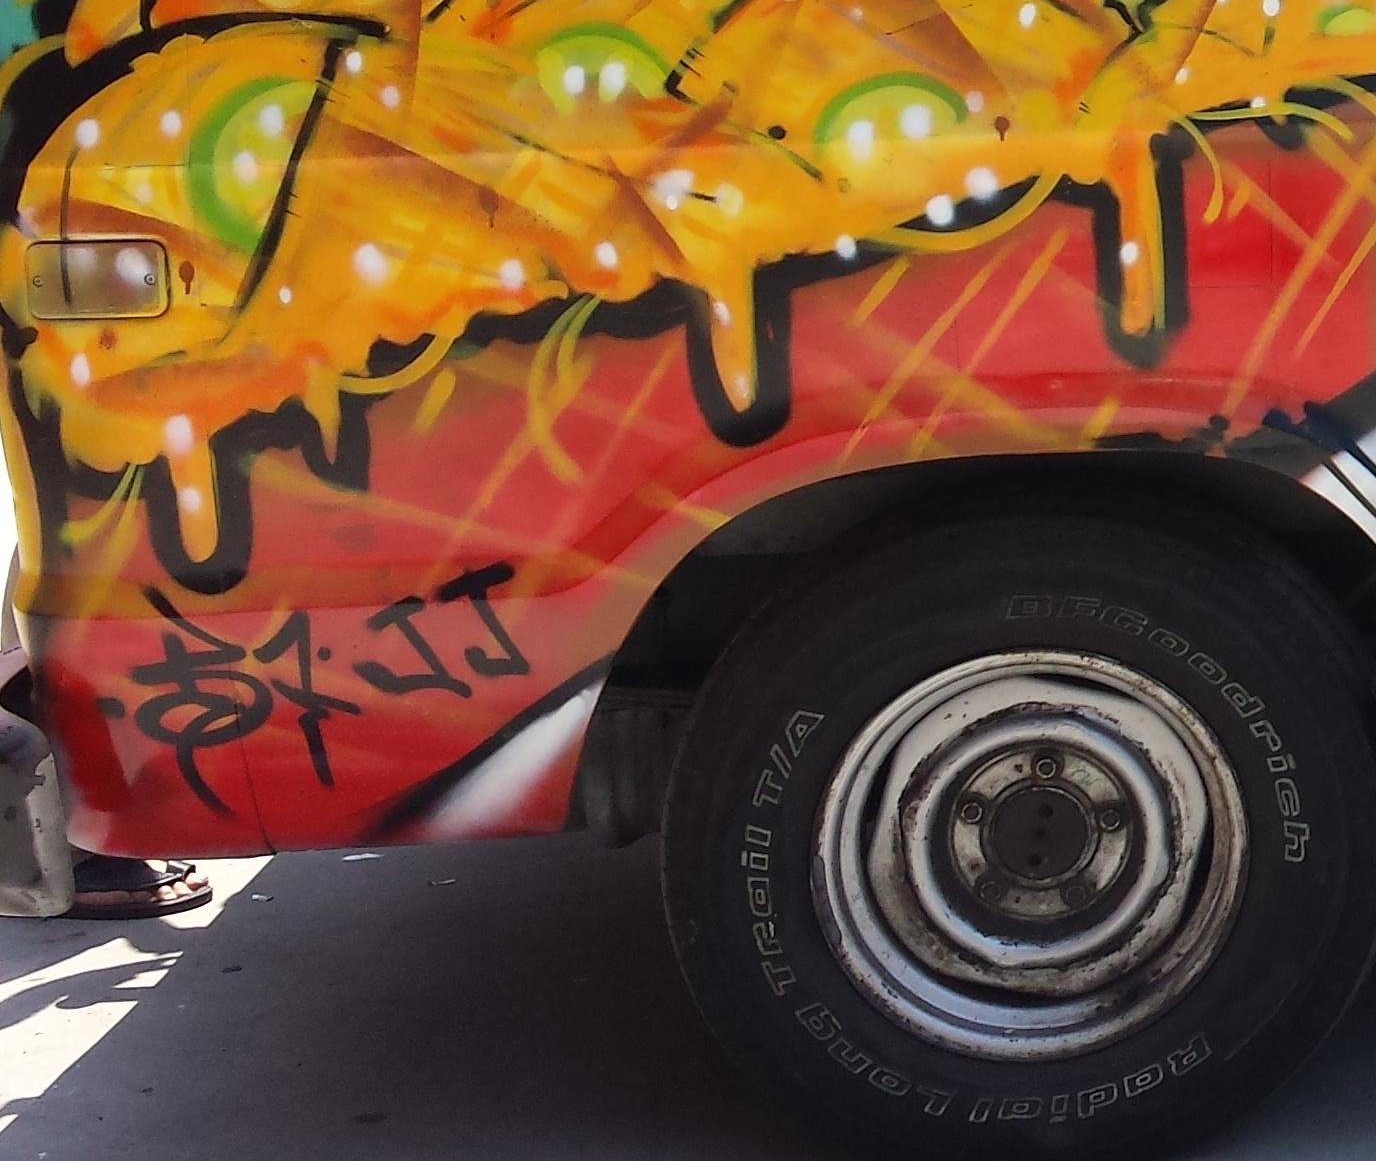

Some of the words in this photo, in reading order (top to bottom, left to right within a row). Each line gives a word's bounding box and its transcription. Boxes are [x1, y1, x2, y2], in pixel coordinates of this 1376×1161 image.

[752, 708, 826, 807] T/A
[1003, 594, 1311, 864] BFGoodrich
[740, 823, 798, 997] Trail
[795, 1002, 957, 1117] Long
[967, 1033, 1213, 1124] Radial
